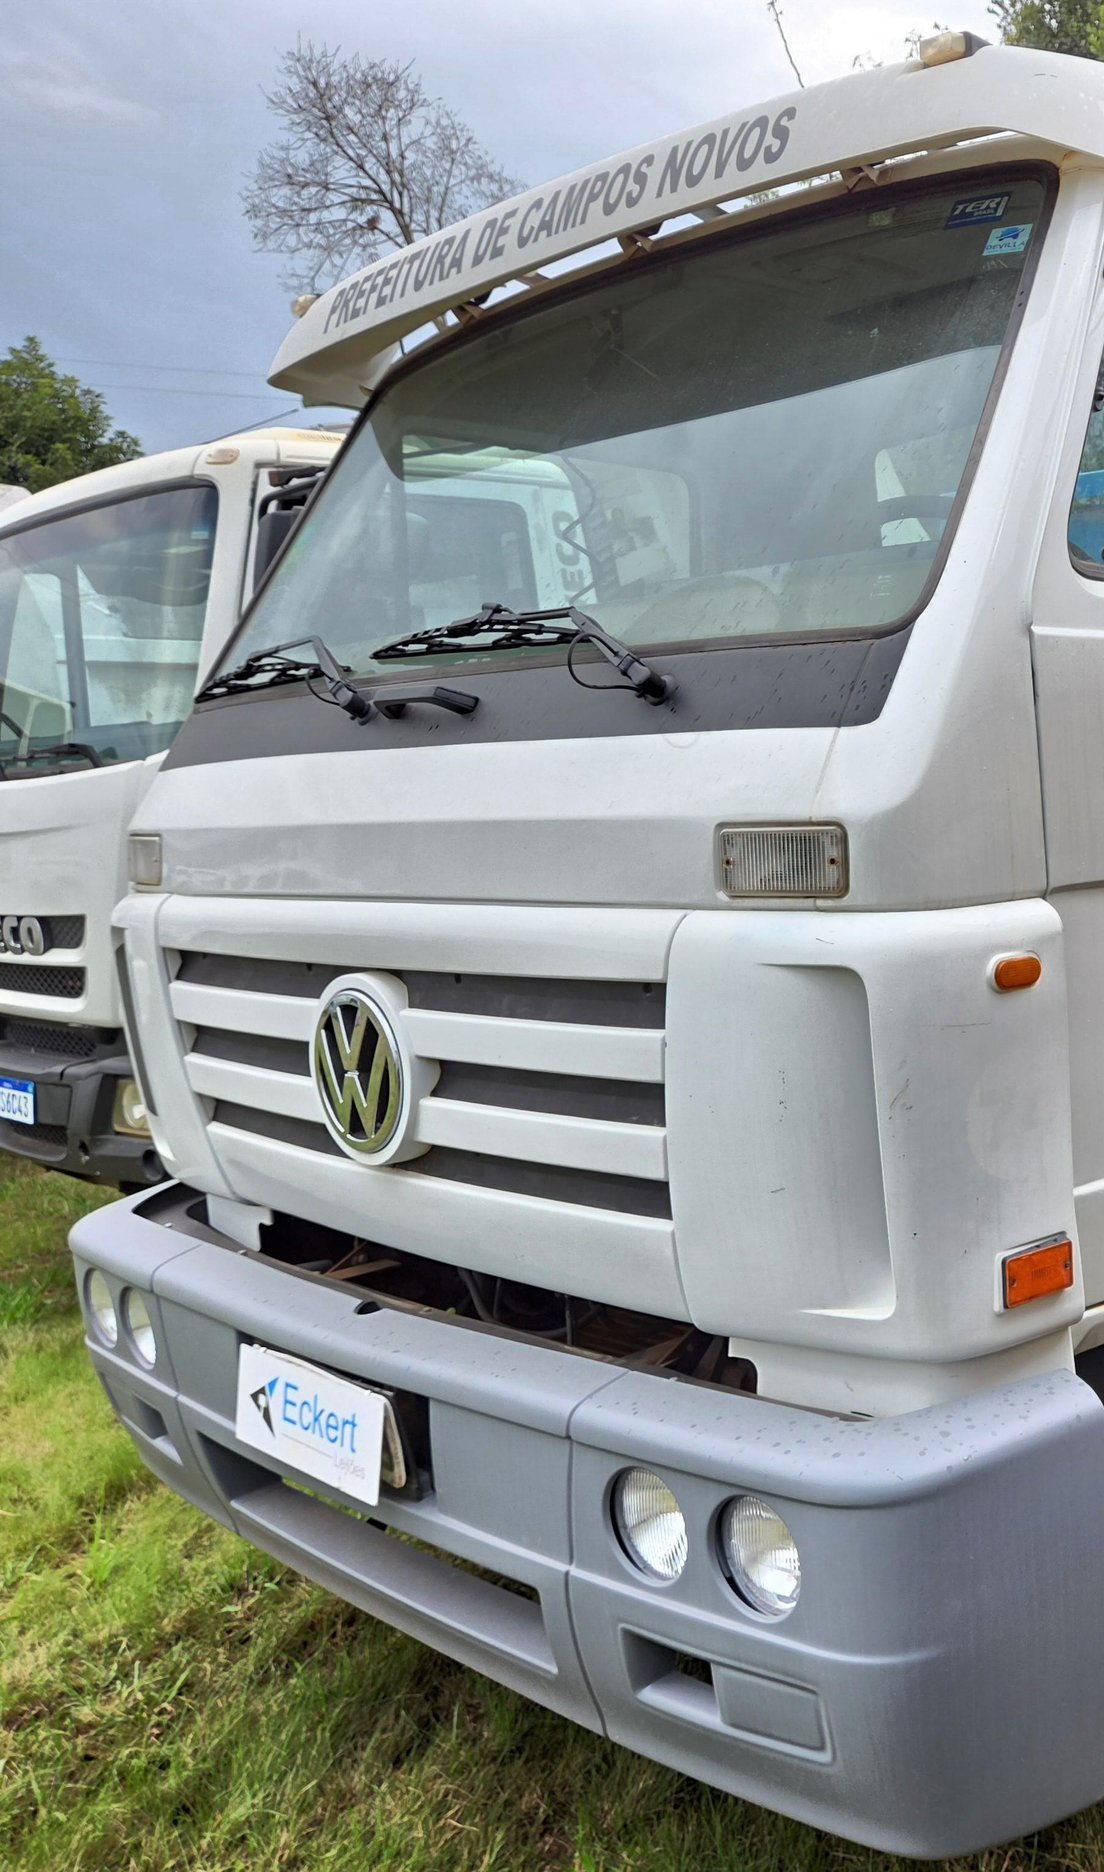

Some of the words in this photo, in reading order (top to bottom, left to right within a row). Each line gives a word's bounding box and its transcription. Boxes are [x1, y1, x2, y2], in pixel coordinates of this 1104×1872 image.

[323, 227, 472, 334] PREFEITURA
[471, 207, 516, 269] DE
[516, 153, 655, 250] CAMPOS
[655, 105, 797, 199] NOVOS
[0, 915, 45, 956] CO
[281, 1381, 358, 1453] Eckert
